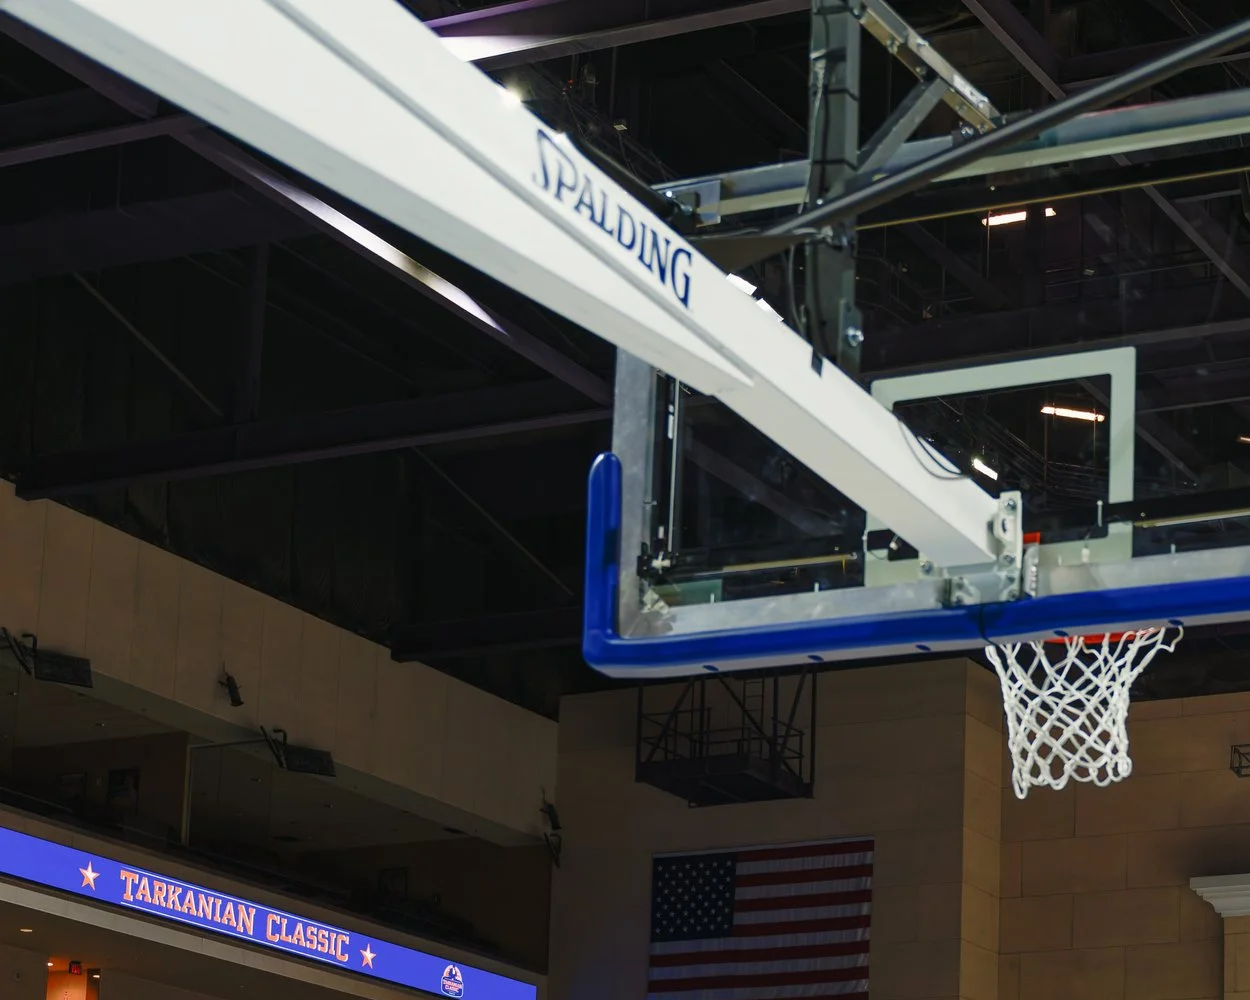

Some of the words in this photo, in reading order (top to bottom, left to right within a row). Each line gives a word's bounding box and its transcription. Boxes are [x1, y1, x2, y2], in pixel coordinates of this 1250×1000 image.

[531, 128, 693, 310] SPALDING
[120, 869, 256, 936] TARKANIAN
[266, 913, 350, 962] CLASSIC
